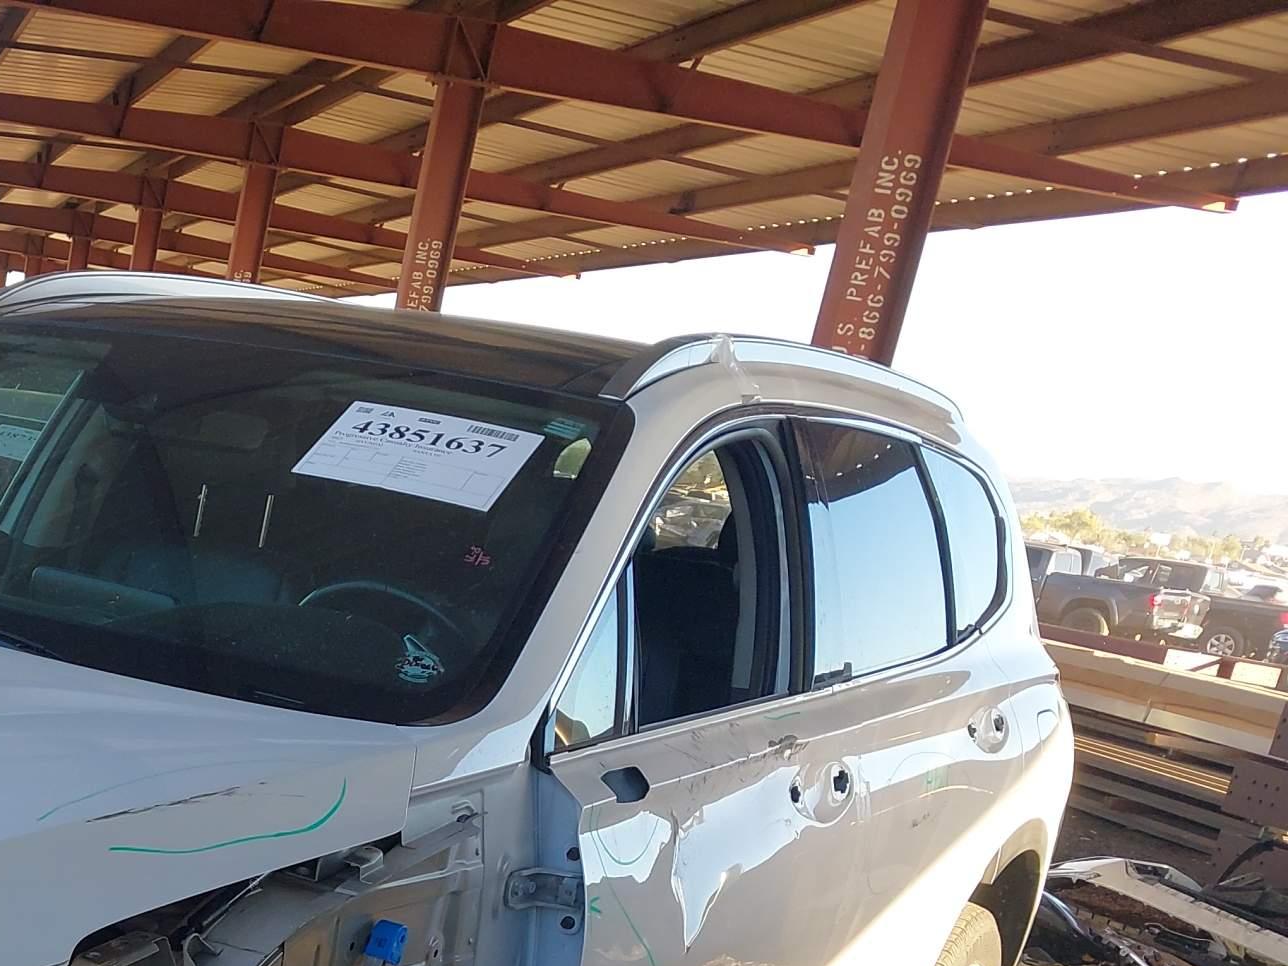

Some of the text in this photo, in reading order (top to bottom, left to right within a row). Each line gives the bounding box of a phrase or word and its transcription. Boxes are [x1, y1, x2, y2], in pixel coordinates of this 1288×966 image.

[845, 207, 885, 301] PREFAB
[873, 149, 902, 195] INC.
[407, 237, 431, 309] EFAB INC.
[351, 420, 508, 458] 43851637
